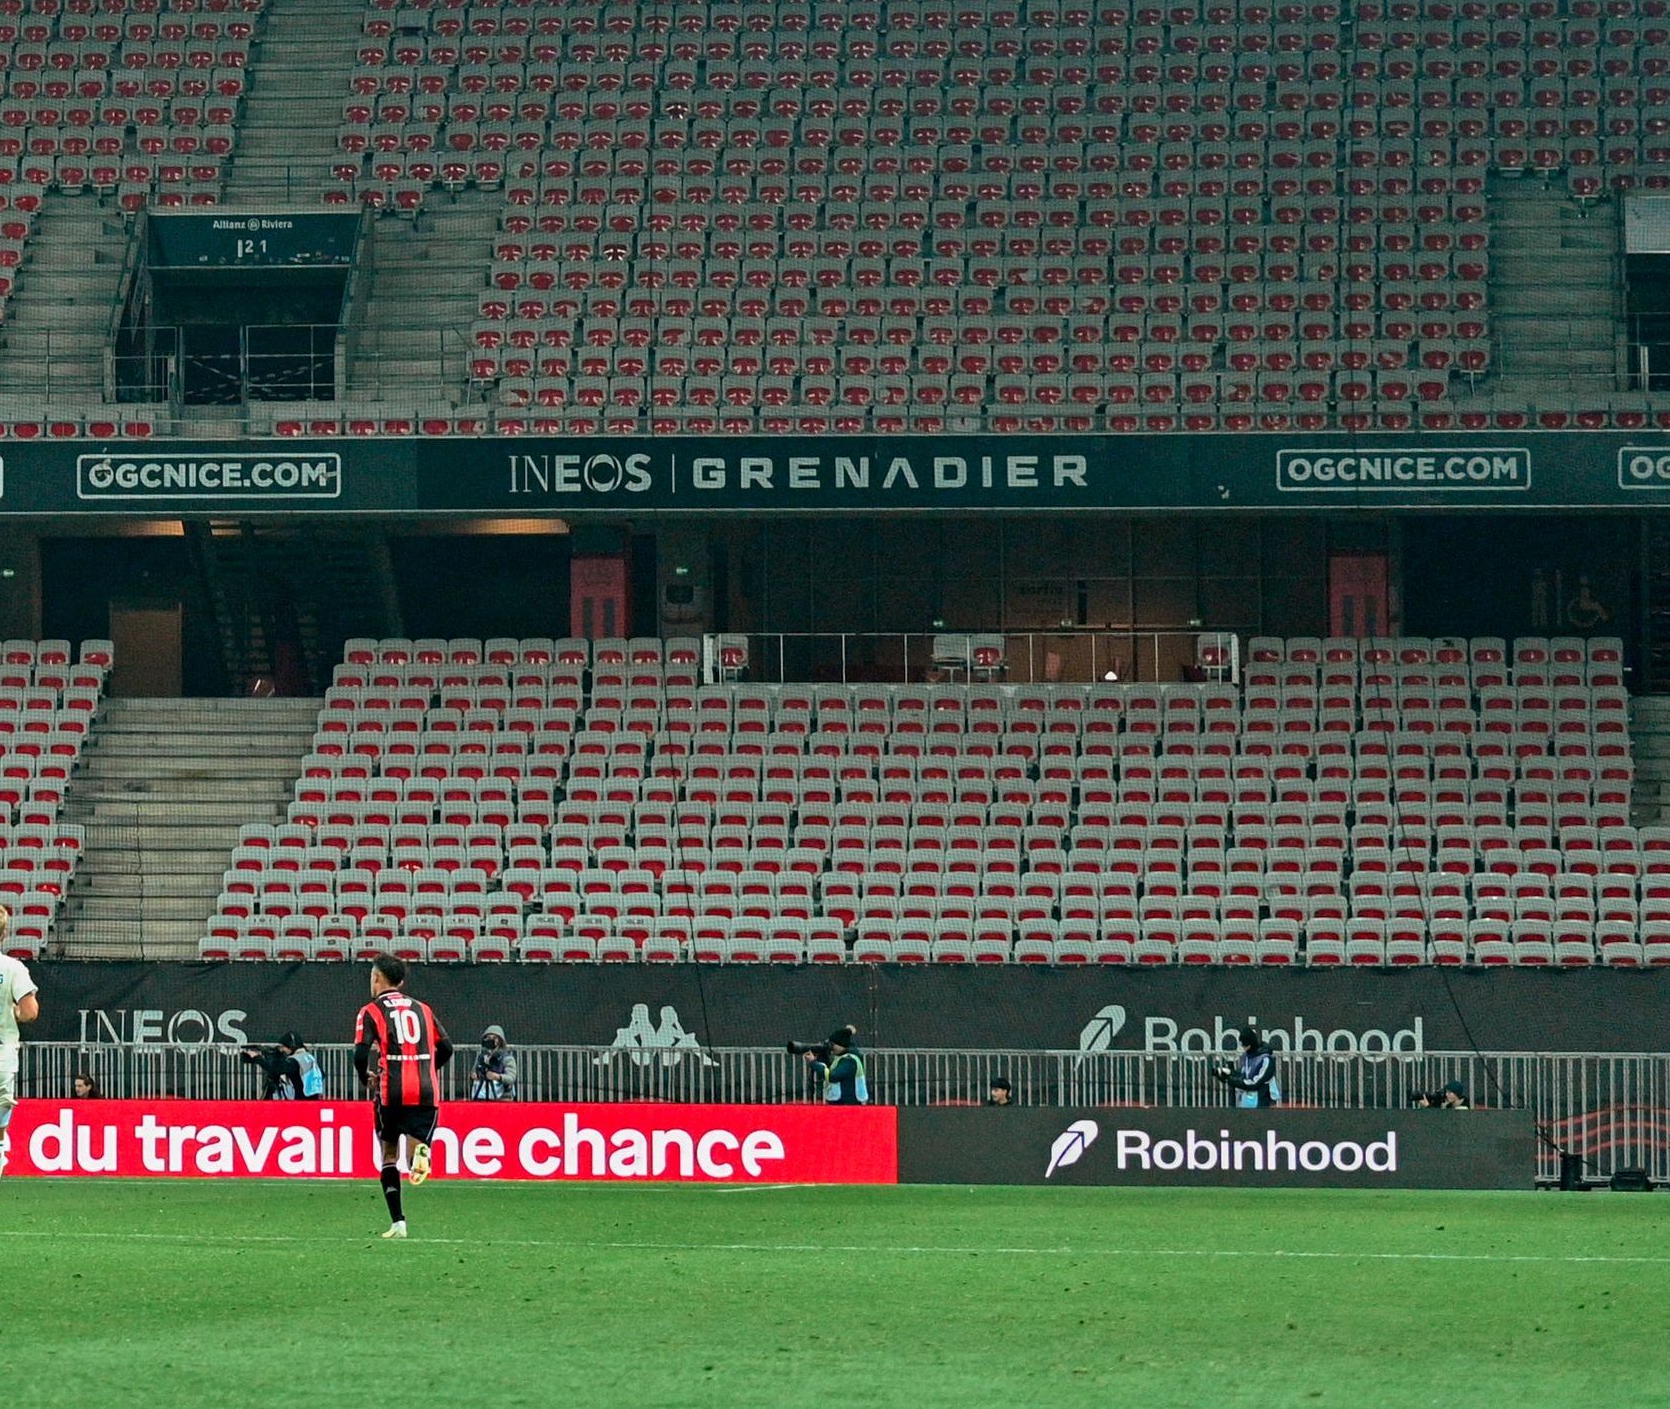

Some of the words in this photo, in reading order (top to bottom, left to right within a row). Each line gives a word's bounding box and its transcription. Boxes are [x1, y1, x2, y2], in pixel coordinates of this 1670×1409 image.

[212, 219, 246, 230] Allianz
[261, 219, 293, 229] Riviera
[89, 459, 328, 489] OGCNICE.COM
[509, 453, 652, 493] INEOS
[692, 454, 1088, 489] GRENADIER
[1287, 457, 1518, 482] OGCNICE.COM
[78, 1008, 249, 1055] INEOS
[390, 1009, 421, 1045] 10
[29, 1108, 118, 1172] du
[518, 1112, 785, 1178] chance
[1117, 1129, 1397, 1173] Robinhood
